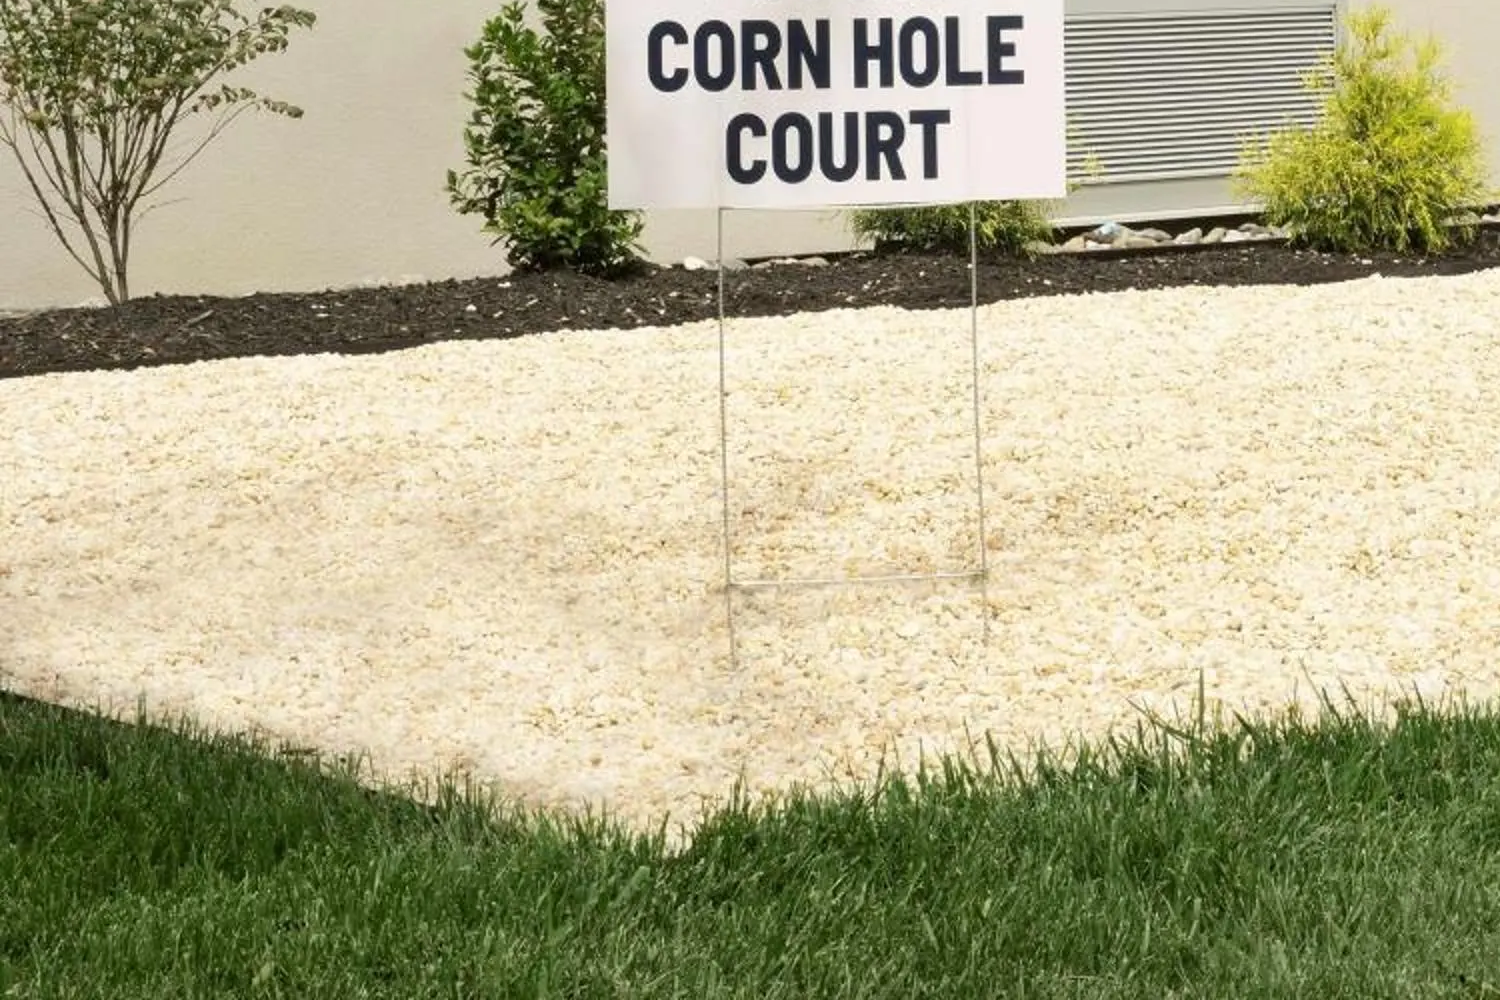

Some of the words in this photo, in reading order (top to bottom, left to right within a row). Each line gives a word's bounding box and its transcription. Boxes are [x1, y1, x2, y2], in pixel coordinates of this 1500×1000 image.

[647, 18, 831, 93] CORN
[853, 15, 1025, 89] HOLE
[725, 109, 951, 185] COURT
